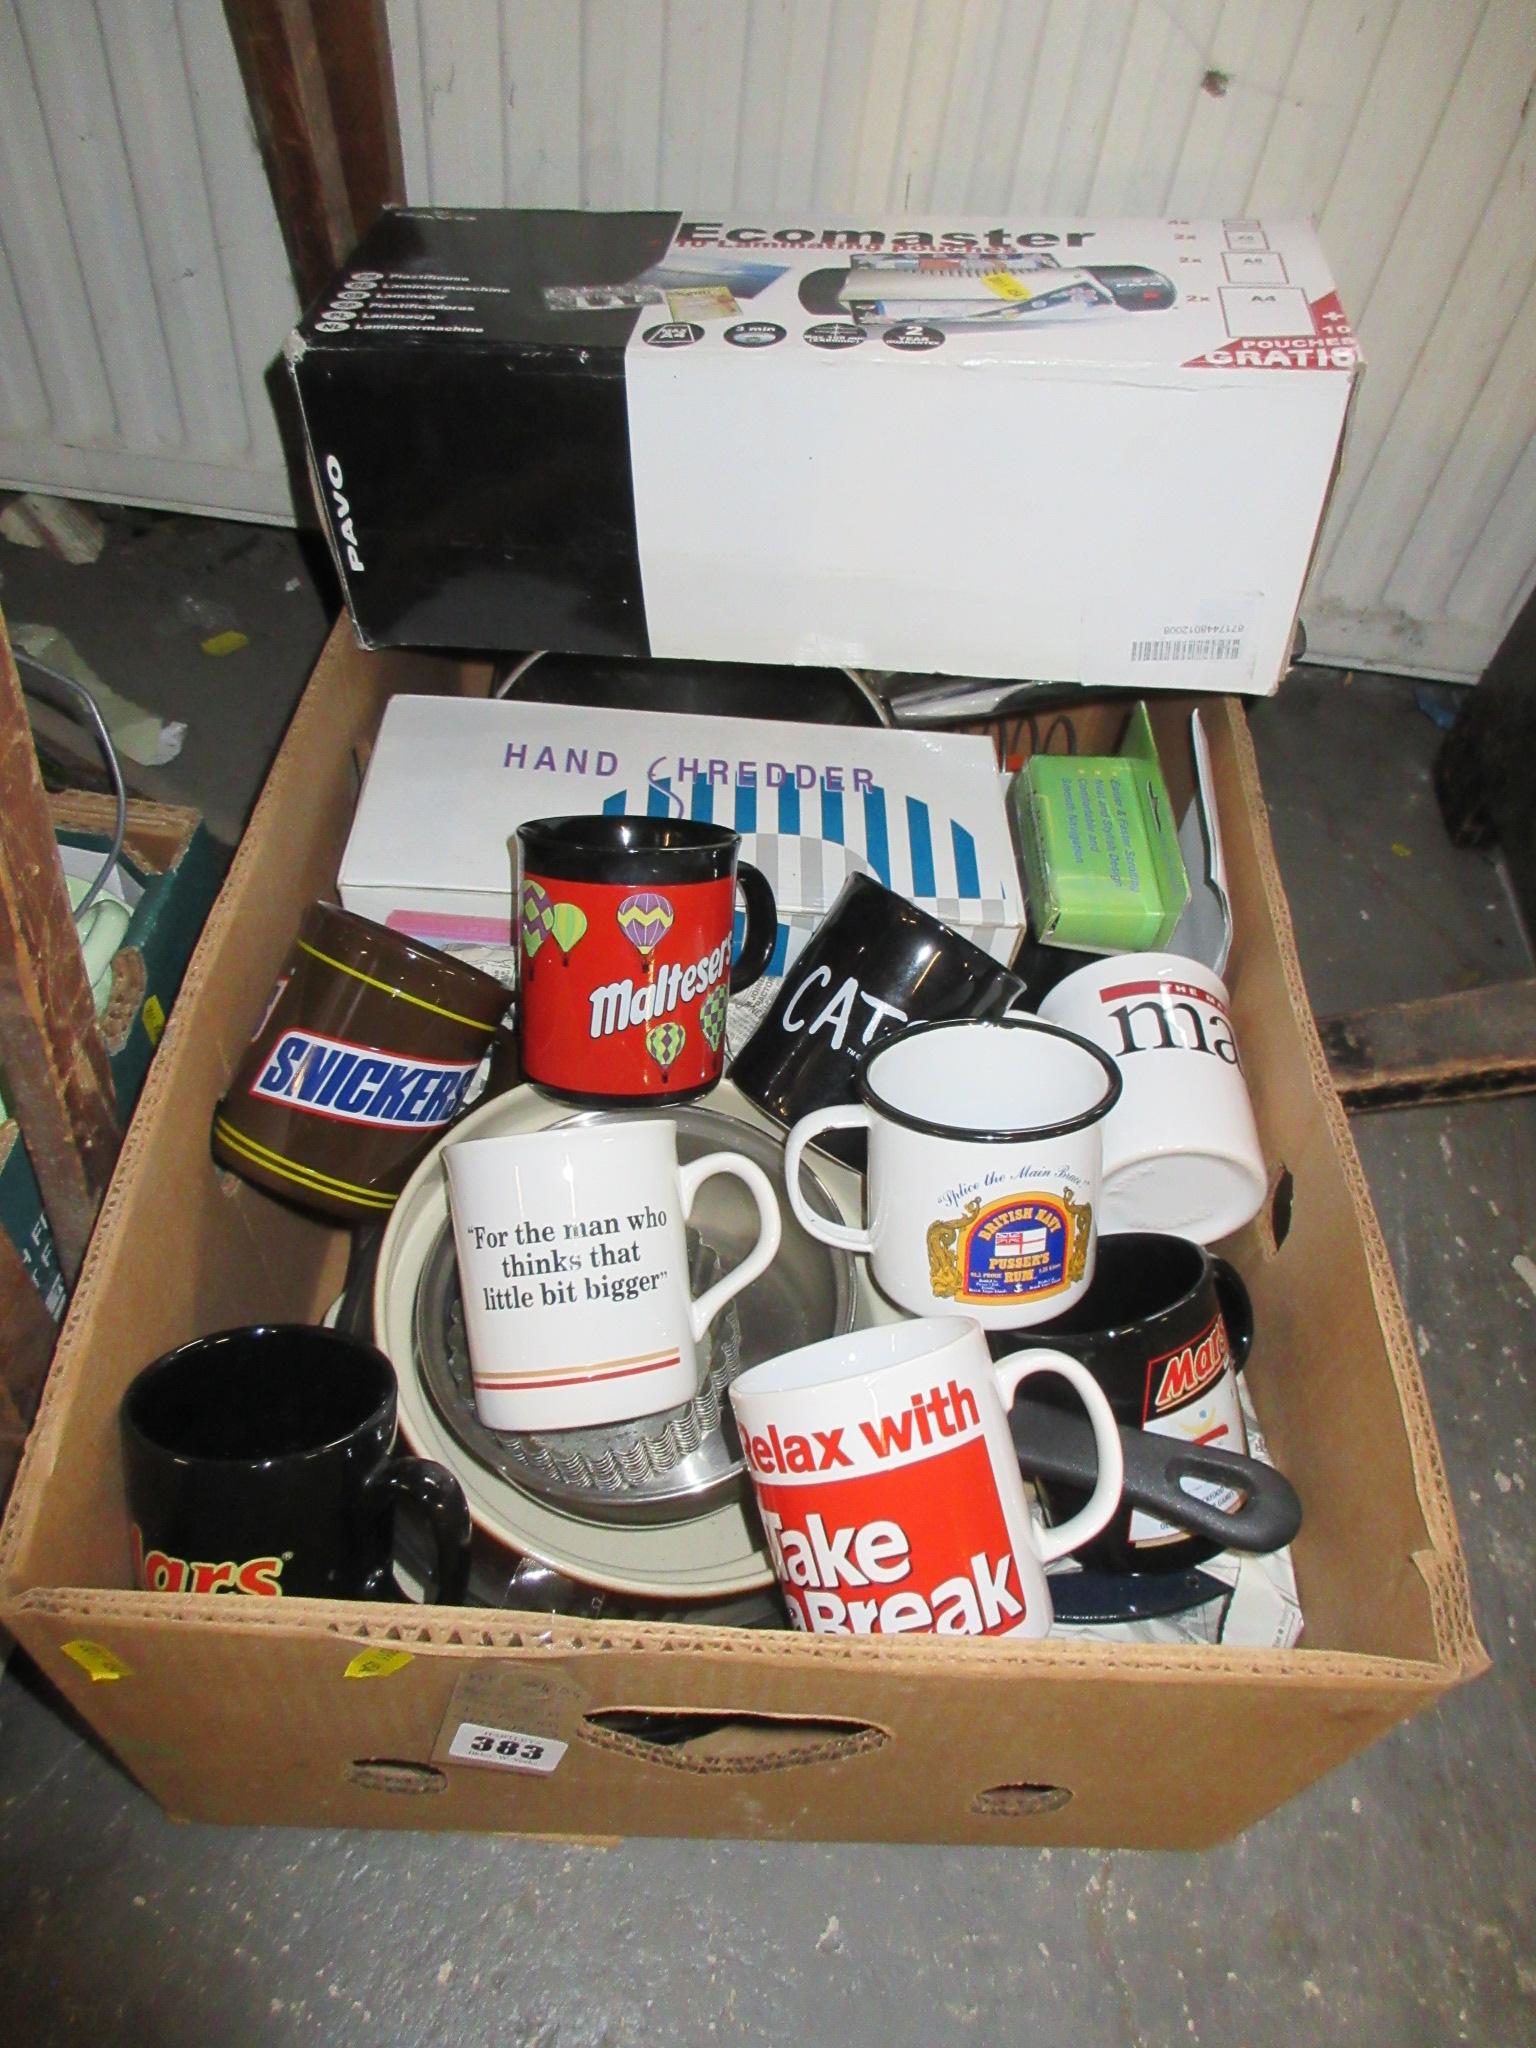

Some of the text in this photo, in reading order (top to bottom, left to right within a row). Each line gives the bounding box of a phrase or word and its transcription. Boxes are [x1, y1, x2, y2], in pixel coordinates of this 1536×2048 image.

[677, 222, 1096, 248] Ecomaster
[375, 292, 448, 301] Laminator
[354, 323, 485, 334] Lamineermachine
[361, 312, 437, 321] Laminacja
[905, 325, 924, 336] 2
[1322, 325, 1351, 335] 10
[1204, 347, 1357, 367] GRATIS
[326, 454, 365, 572] PAVO
[503, 743, 874, 820] HAND SHREDDER
[783, 965, 929, 1050] CAT
[984, 1170, 1006, 1188] the
[1010, 1165, 1051, 1181] Main
[468, 1206, 667, 1250] "For the man who
[978, 1207, 1035, 1241] BRITISH
[502, 1241, 641, 1279] thinks that
[989, 1252, 1050, 1271] PUSSER'S
[1004, 1269, 1035, 1284] RUM
[483, 1270, 668, 1312] little bit bigger"
[858, 1379, 981, 1459] with
[760, 1508, 912, 1589] Take
[803, 1551, 1023, 1636] Break
[471, 1735, 545, 1760] 383
